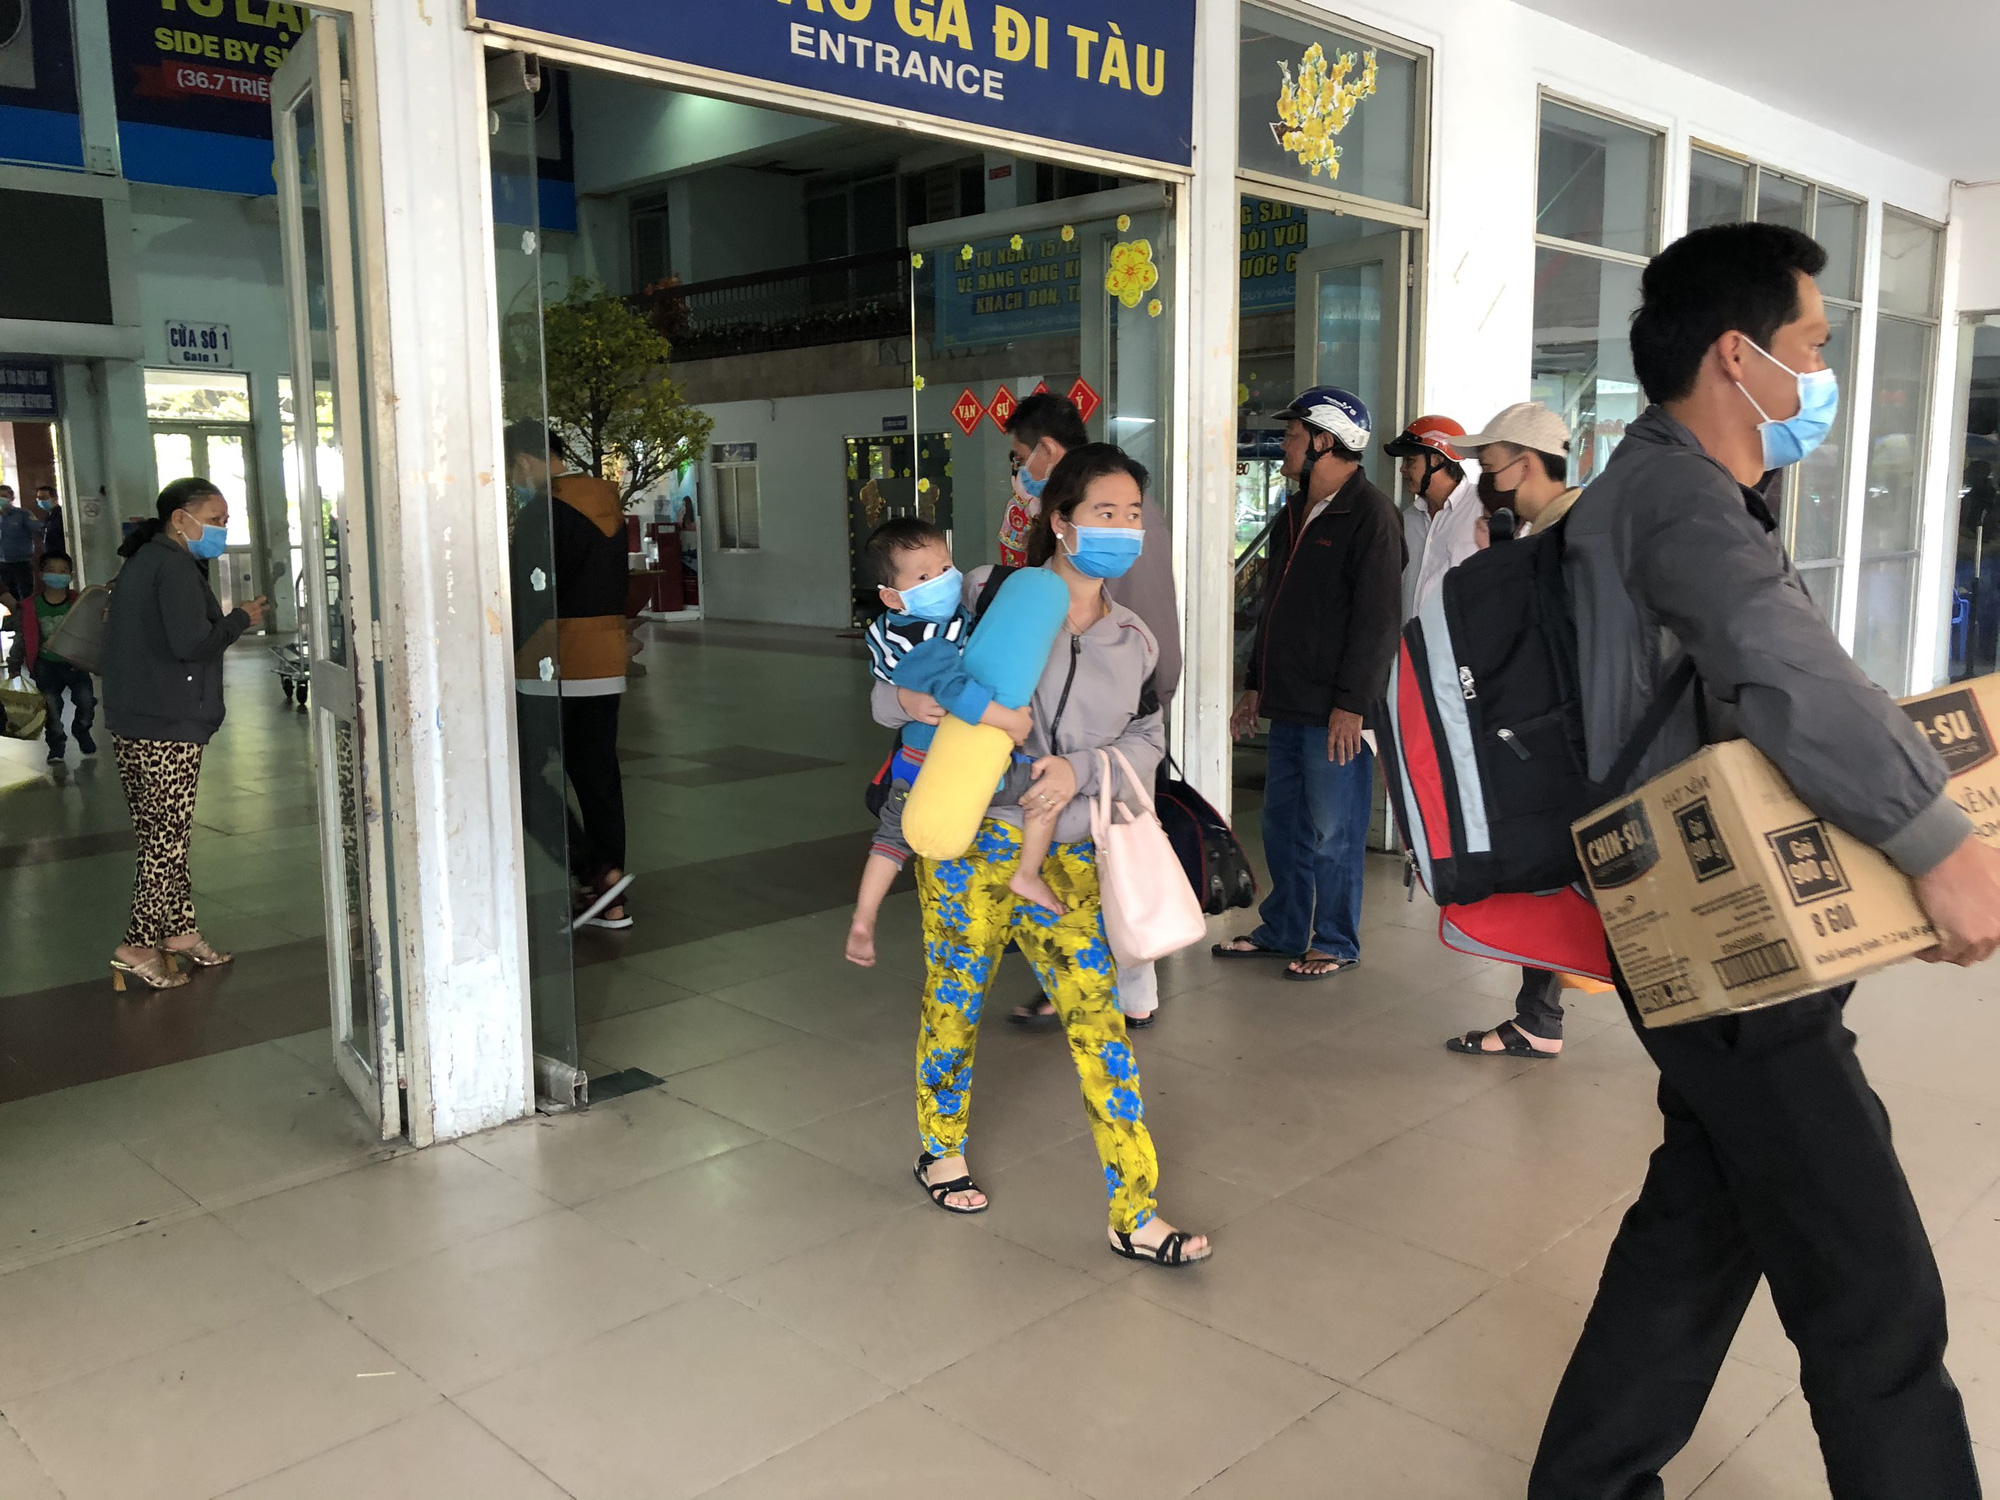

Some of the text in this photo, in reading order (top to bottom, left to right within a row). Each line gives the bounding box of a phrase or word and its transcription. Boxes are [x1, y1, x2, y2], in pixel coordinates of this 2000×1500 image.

[154, 27, 221, 59] SIDE
[224, 38, 260, 64] BY
[790, 22, 1004, 101] ENTRANCE
[992, 5, 1048, 70] ĐI
[1067, 21, 1165, 96] TÀU
[177, 68, 270, 101] (36.7 TRIỆ
[170, 323, 229, 350] CỬA SỐ 1
[213, 353, 219, 363] 1
[958, 404, 976, 421] VẠN
[996, 399, 1010, 419] SỰ
[1586, 820, 1646, 866] CHIN-SU
